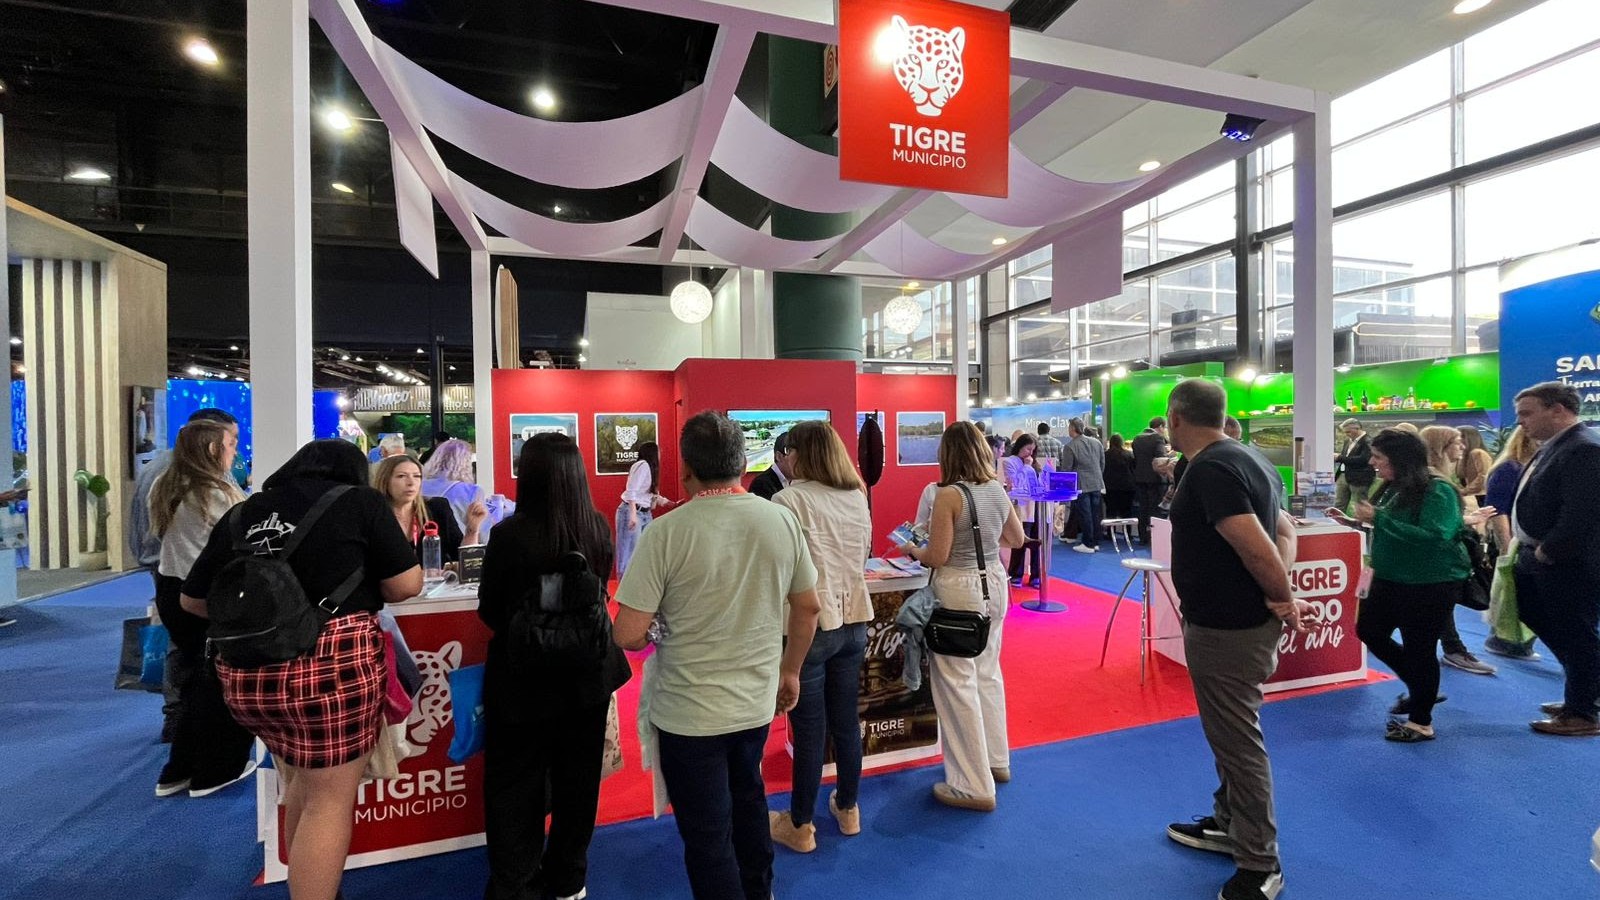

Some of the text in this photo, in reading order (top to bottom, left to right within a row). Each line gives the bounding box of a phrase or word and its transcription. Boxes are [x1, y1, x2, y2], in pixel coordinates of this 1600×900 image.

[889, 122, 966, 155] TIGRE
[892, 148, 966, 169] MUNICIPIO
[615, 451, 640, 459] TIGRE
[1288, 566, 1341, 592] IGRE
[1305, 620, 1345, 651] año
[869, 718, 905, 733] TIGRE
[870, 728, 905, 740] MUNICIPIO
[355, 794, 467, 824] MUNICIPIO
